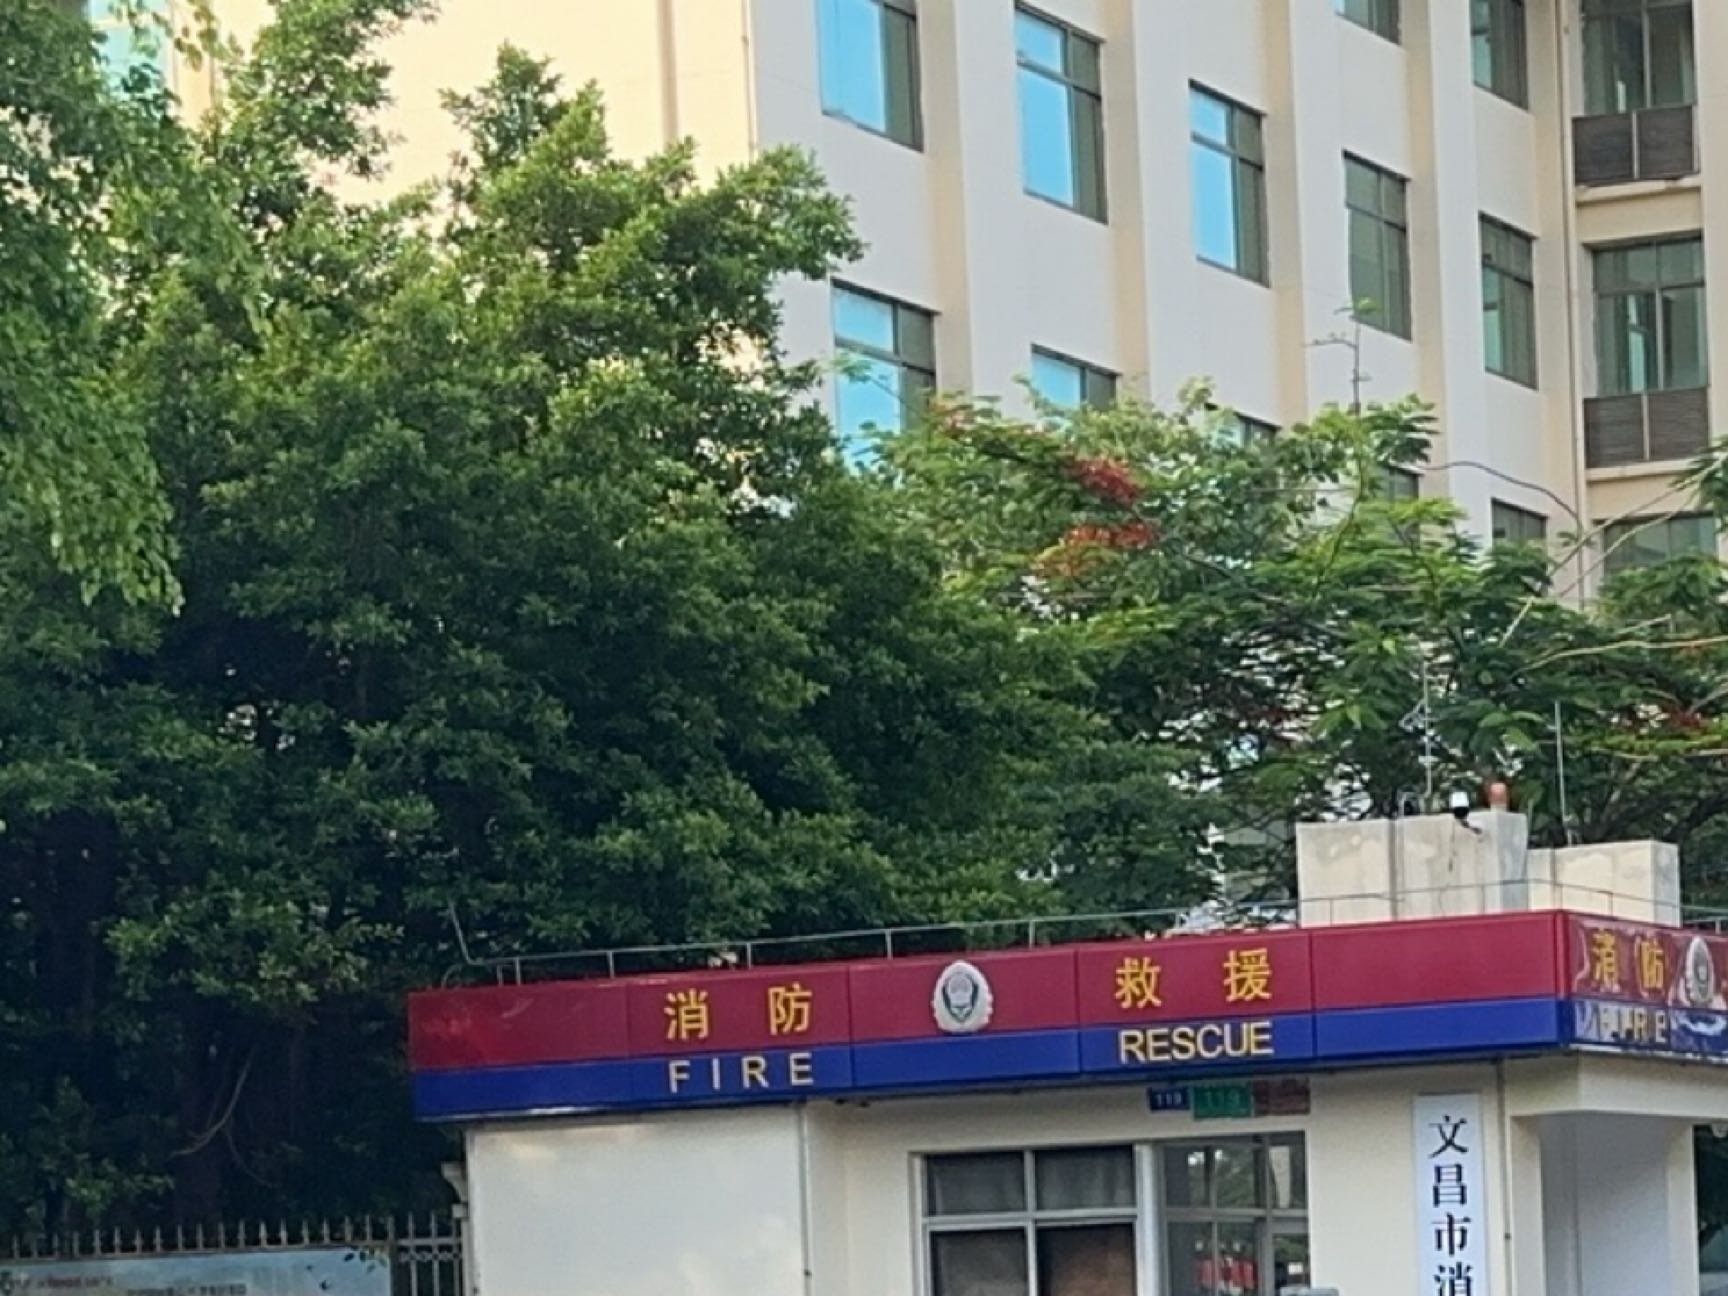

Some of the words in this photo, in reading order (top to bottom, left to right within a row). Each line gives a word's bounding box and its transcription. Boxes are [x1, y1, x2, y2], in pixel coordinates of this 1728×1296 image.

[663, 981, 813, 1041] 消防
[1114, 947, 1273, 1009] 救援
[668, 1051, 814, 1094] FIRE
[1118, 1020, 1274, 1065] RESCUE
